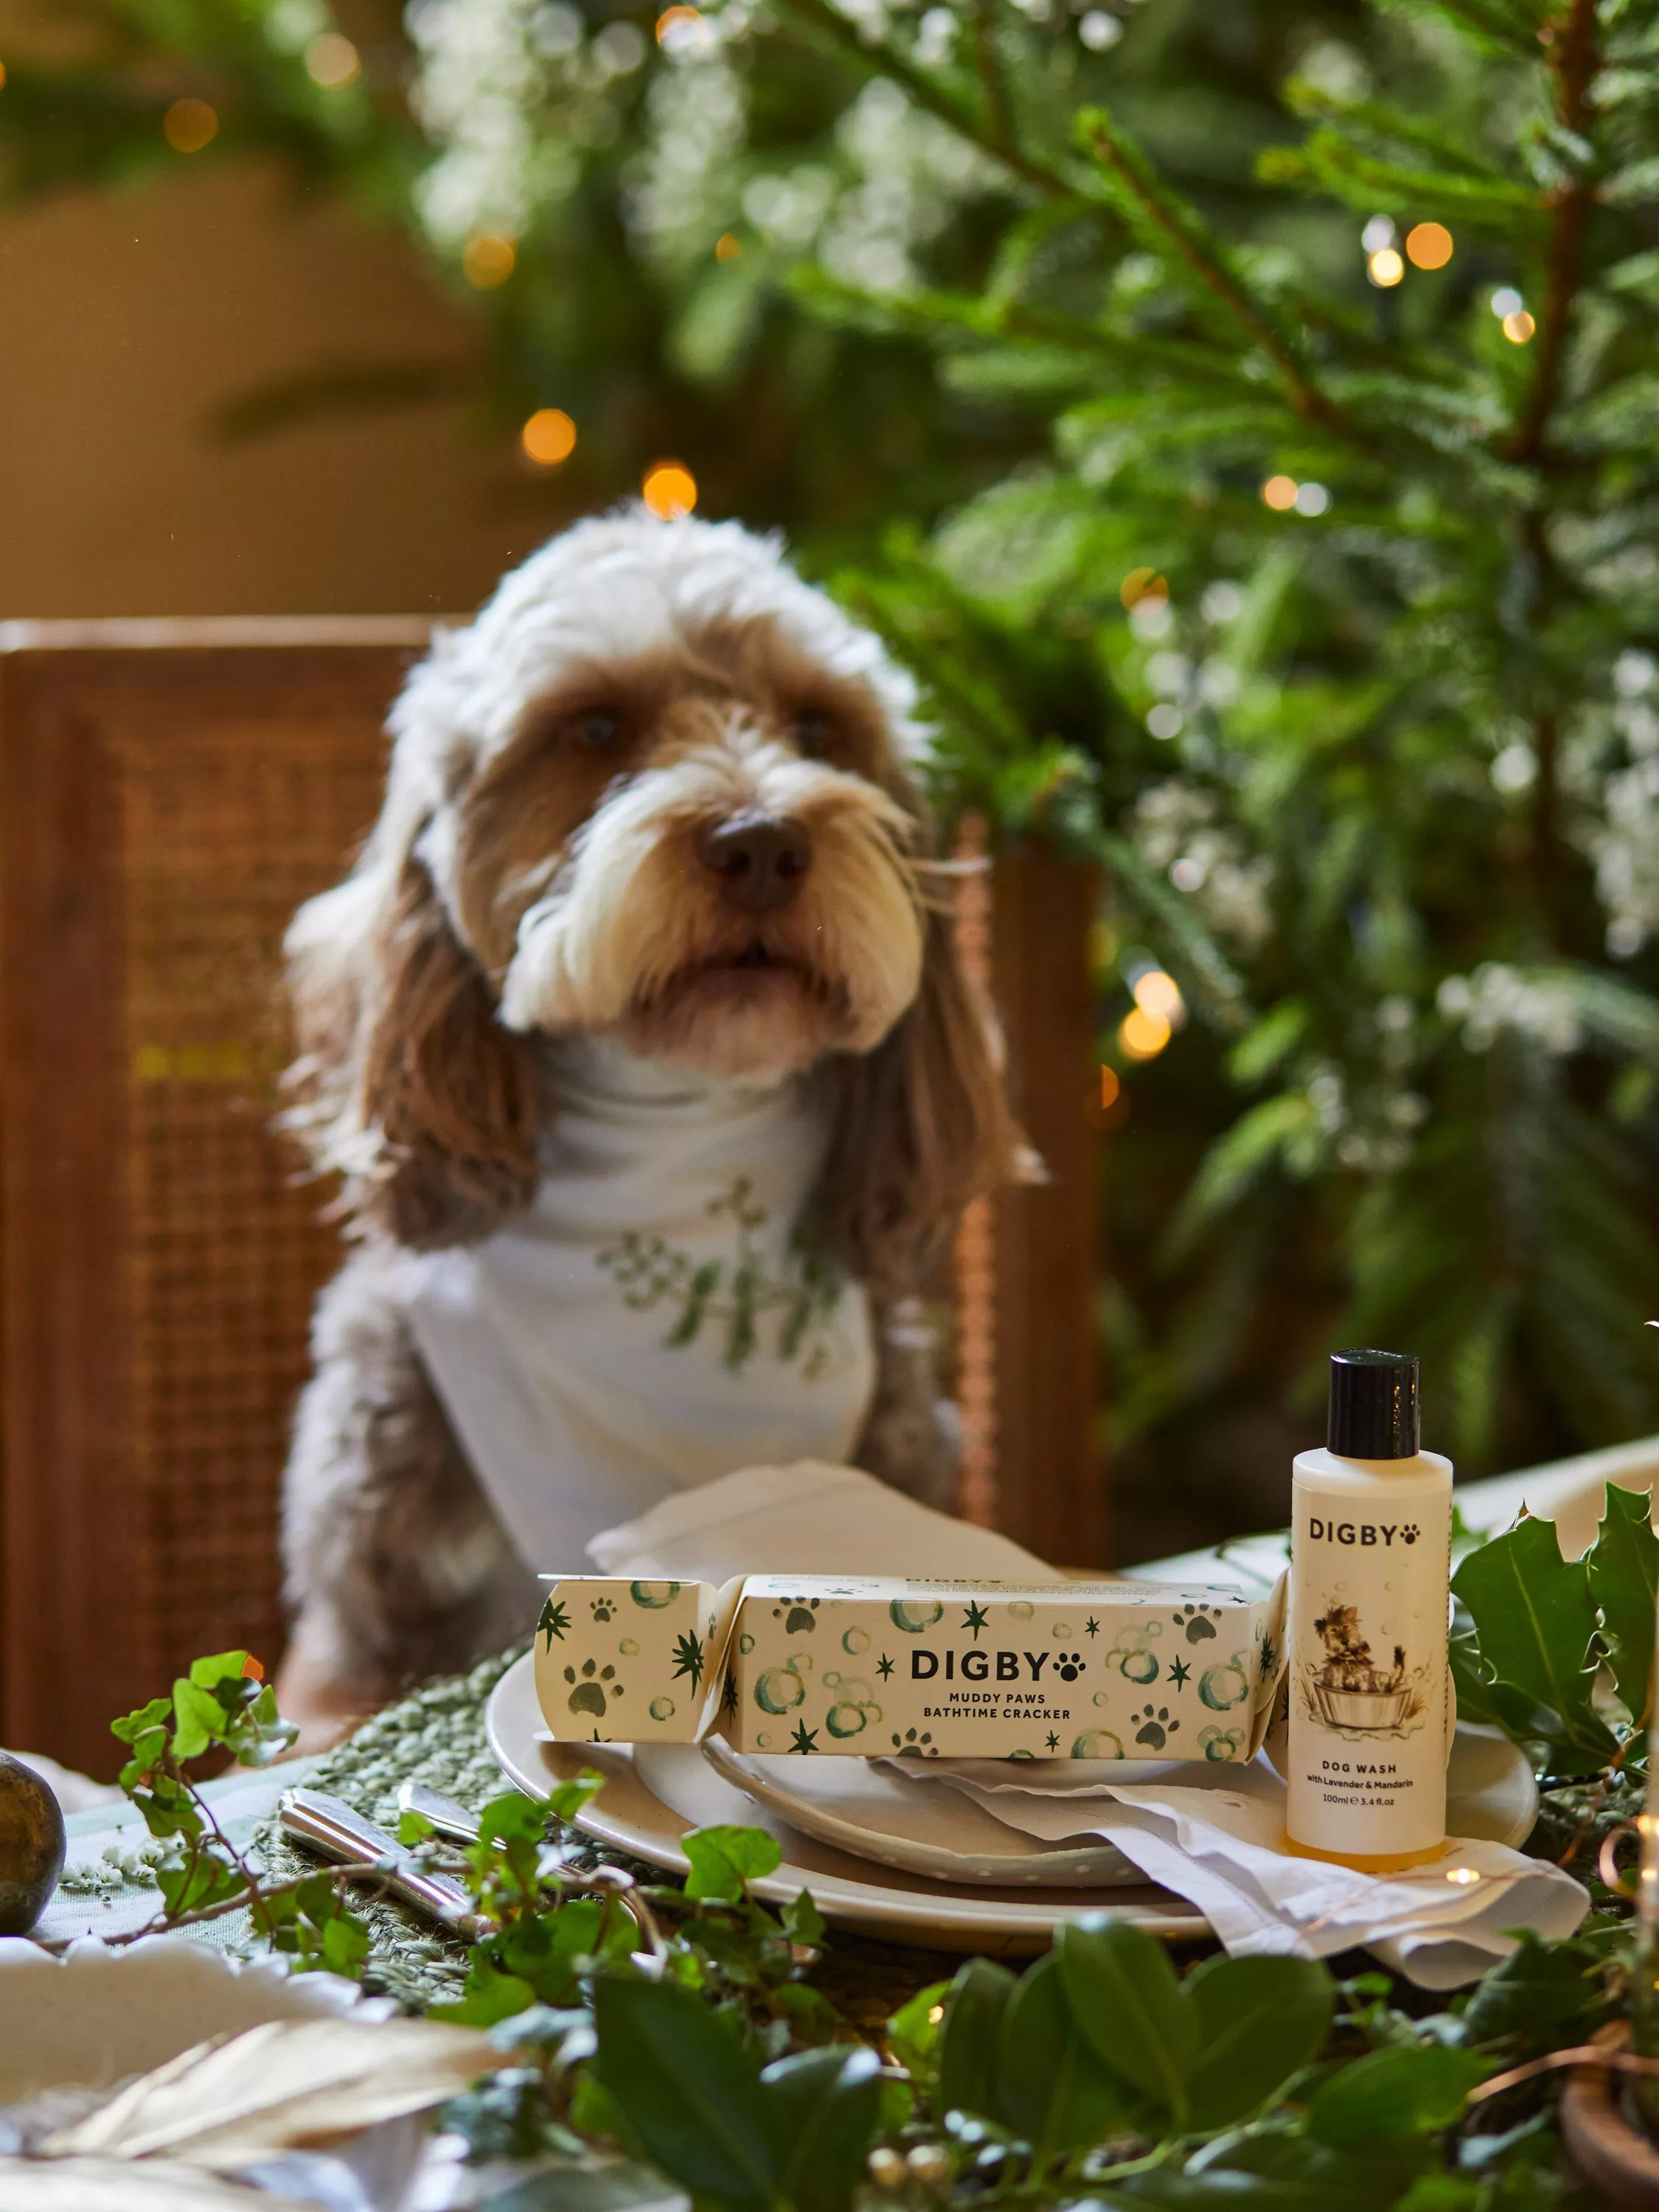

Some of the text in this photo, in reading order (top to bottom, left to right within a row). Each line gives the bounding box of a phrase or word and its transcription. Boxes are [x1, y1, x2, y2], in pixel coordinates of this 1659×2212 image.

[1309, 1517, 1398, 1546] DIGBY
[911, 1649, 1050, 1682] DIGBY
[949, 1693, 1046, 1704] MUDDY PAWS
[923, 1707, 1071, 1719] BATHTIME CRACKER
[1322, 1760, 1397, 1774] DOG WASH
[1307, 1773, 1323, 1784] with
[1324, 1777, 1364, 1789] Lavender
[1374, 1779, 1413, 1790] Mandarin
[1323, 1793, 1349, 1805] 100ml
[1360, 1797, 1374, 1806] 3.4
